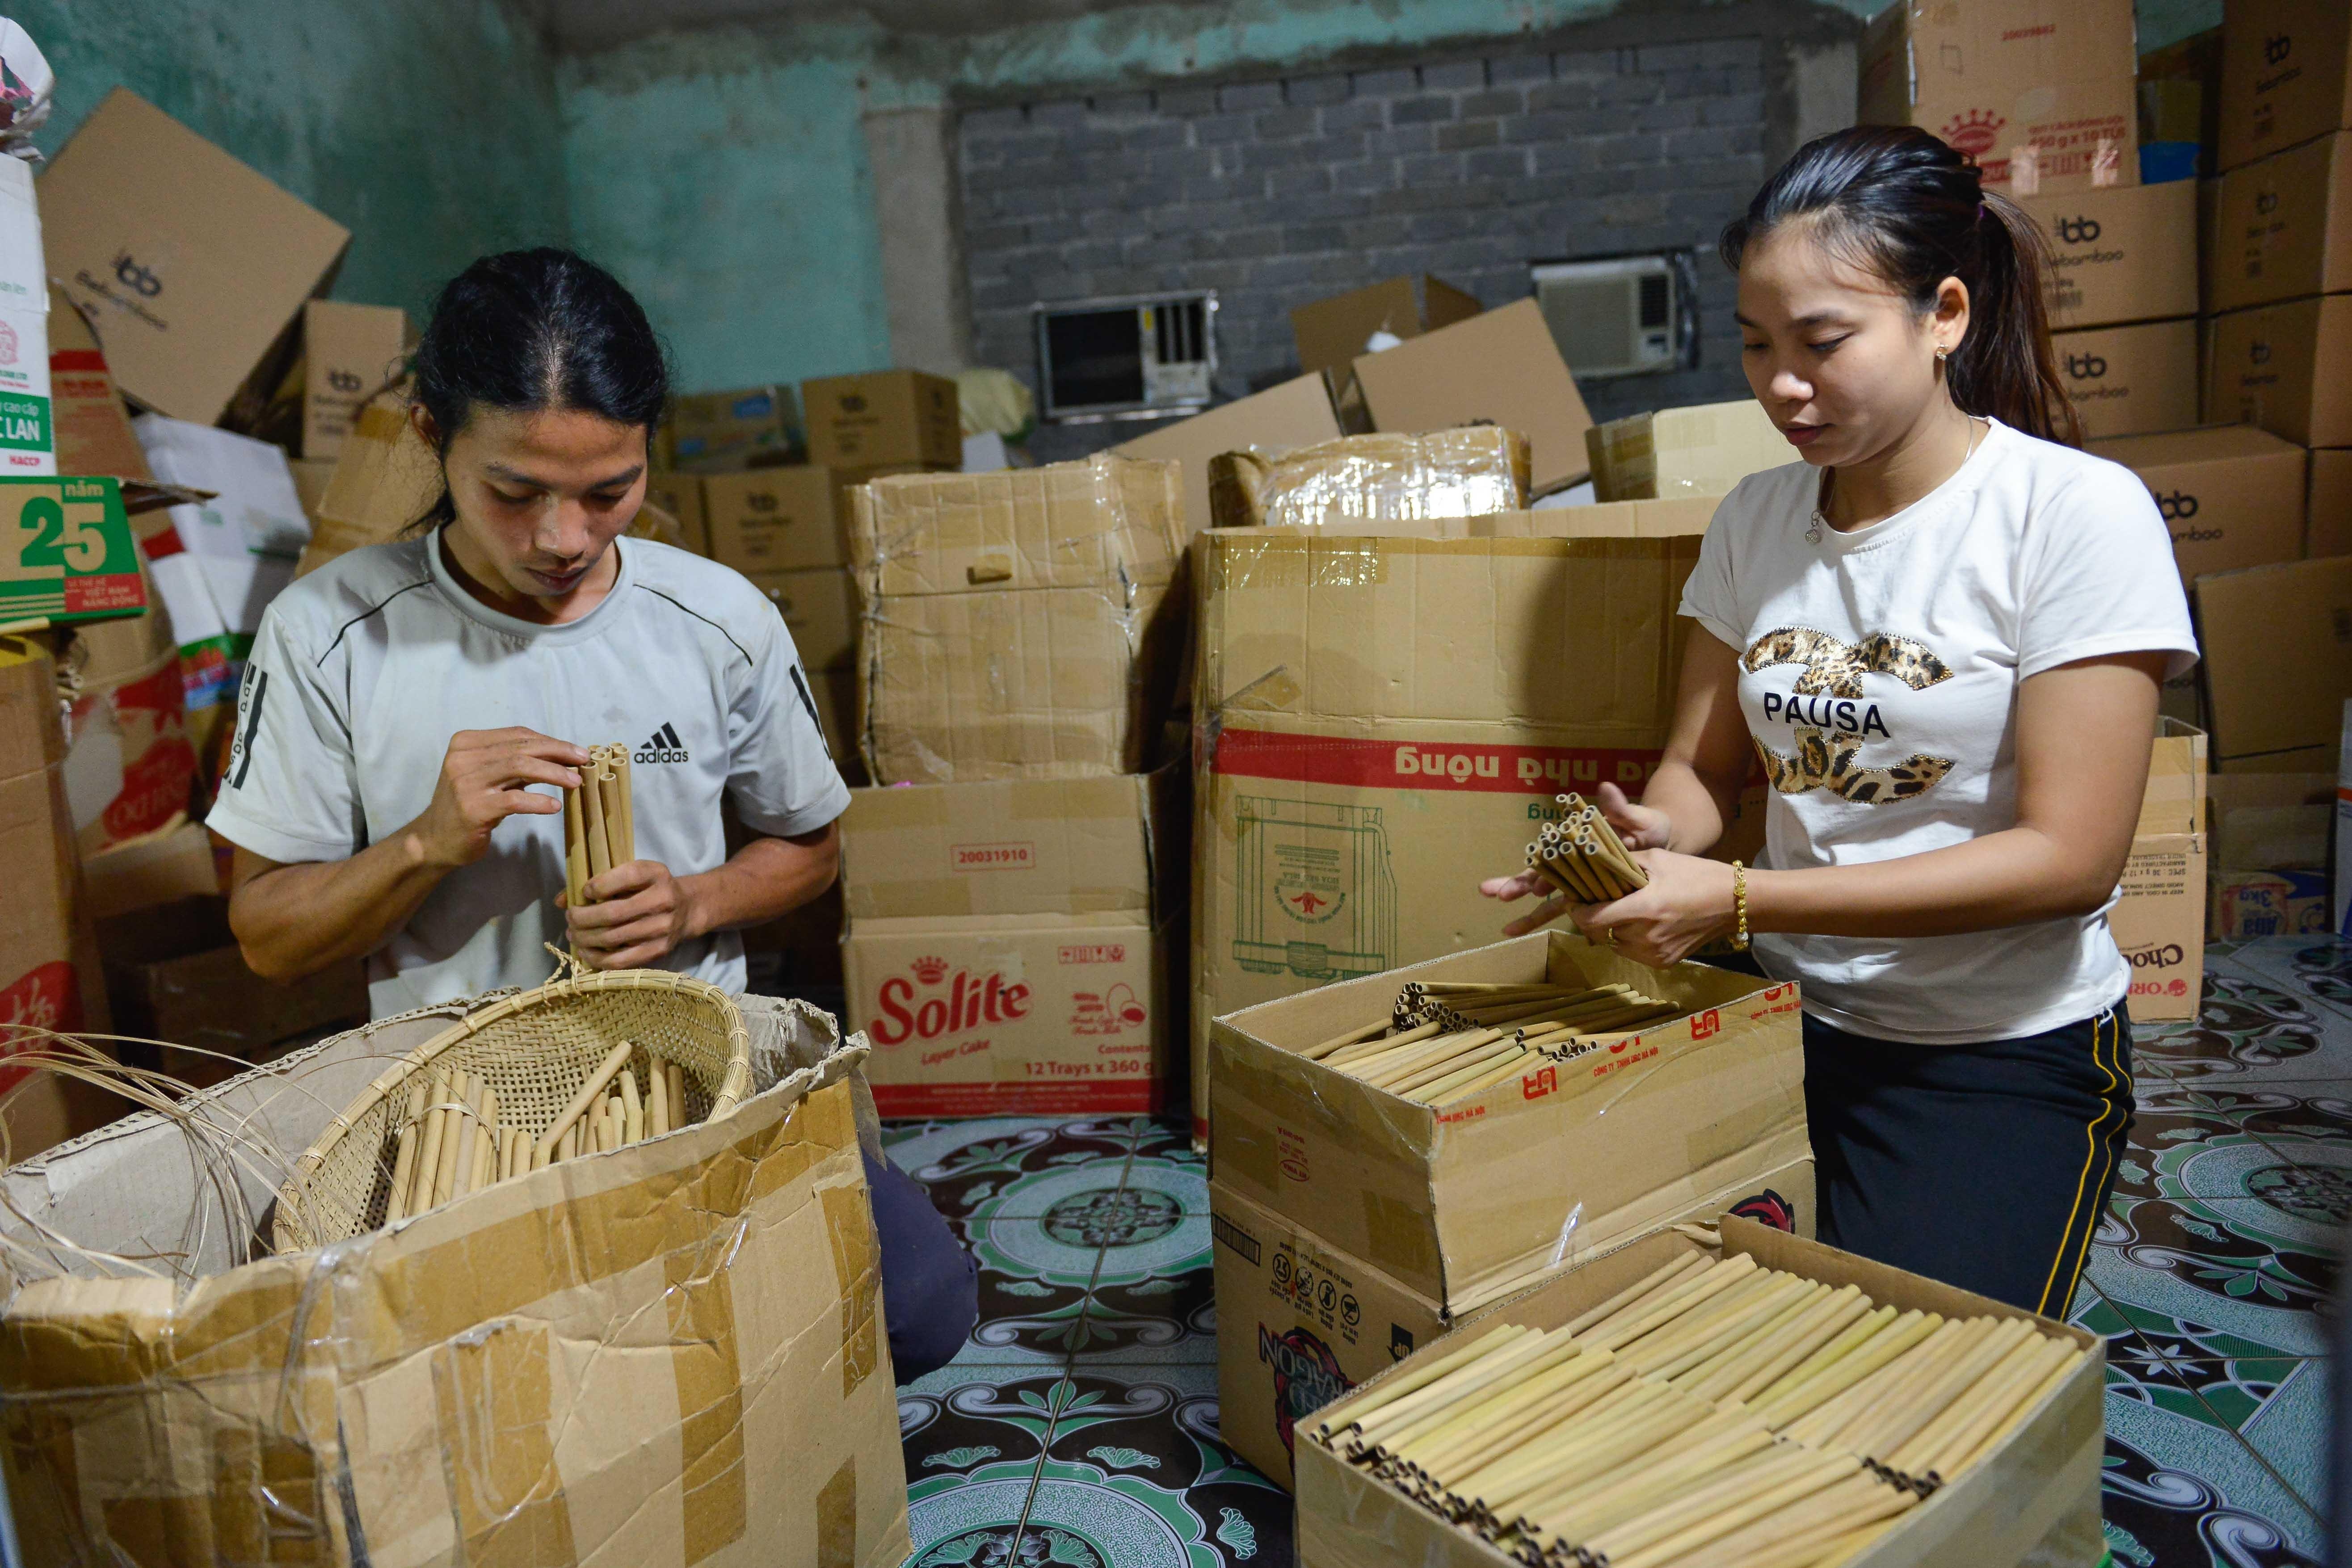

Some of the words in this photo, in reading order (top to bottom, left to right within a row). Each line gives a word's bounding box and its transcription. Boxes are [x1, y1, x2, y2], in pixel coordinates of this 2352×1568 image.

[6, 418, 41, 442] LAN
[20, 496, 107, 572] 25
[1764, 692, 1891, 738] PAUSA
[634, 748, 689, 764] adidas
[1395, 747, 1499, 782] nông
[1518, 757, 1596, 786] nhà
[959, 849, 1027, 863] 20031910
[871, 971, 1029, 1046] Solite
[1026, 1062, 1045, 1075] 12
[1047, 1060, 1091, 1076] Trays
[1095, 1063, 1105, 1072] x
[1109, 1059, 1140, 1073] 360
